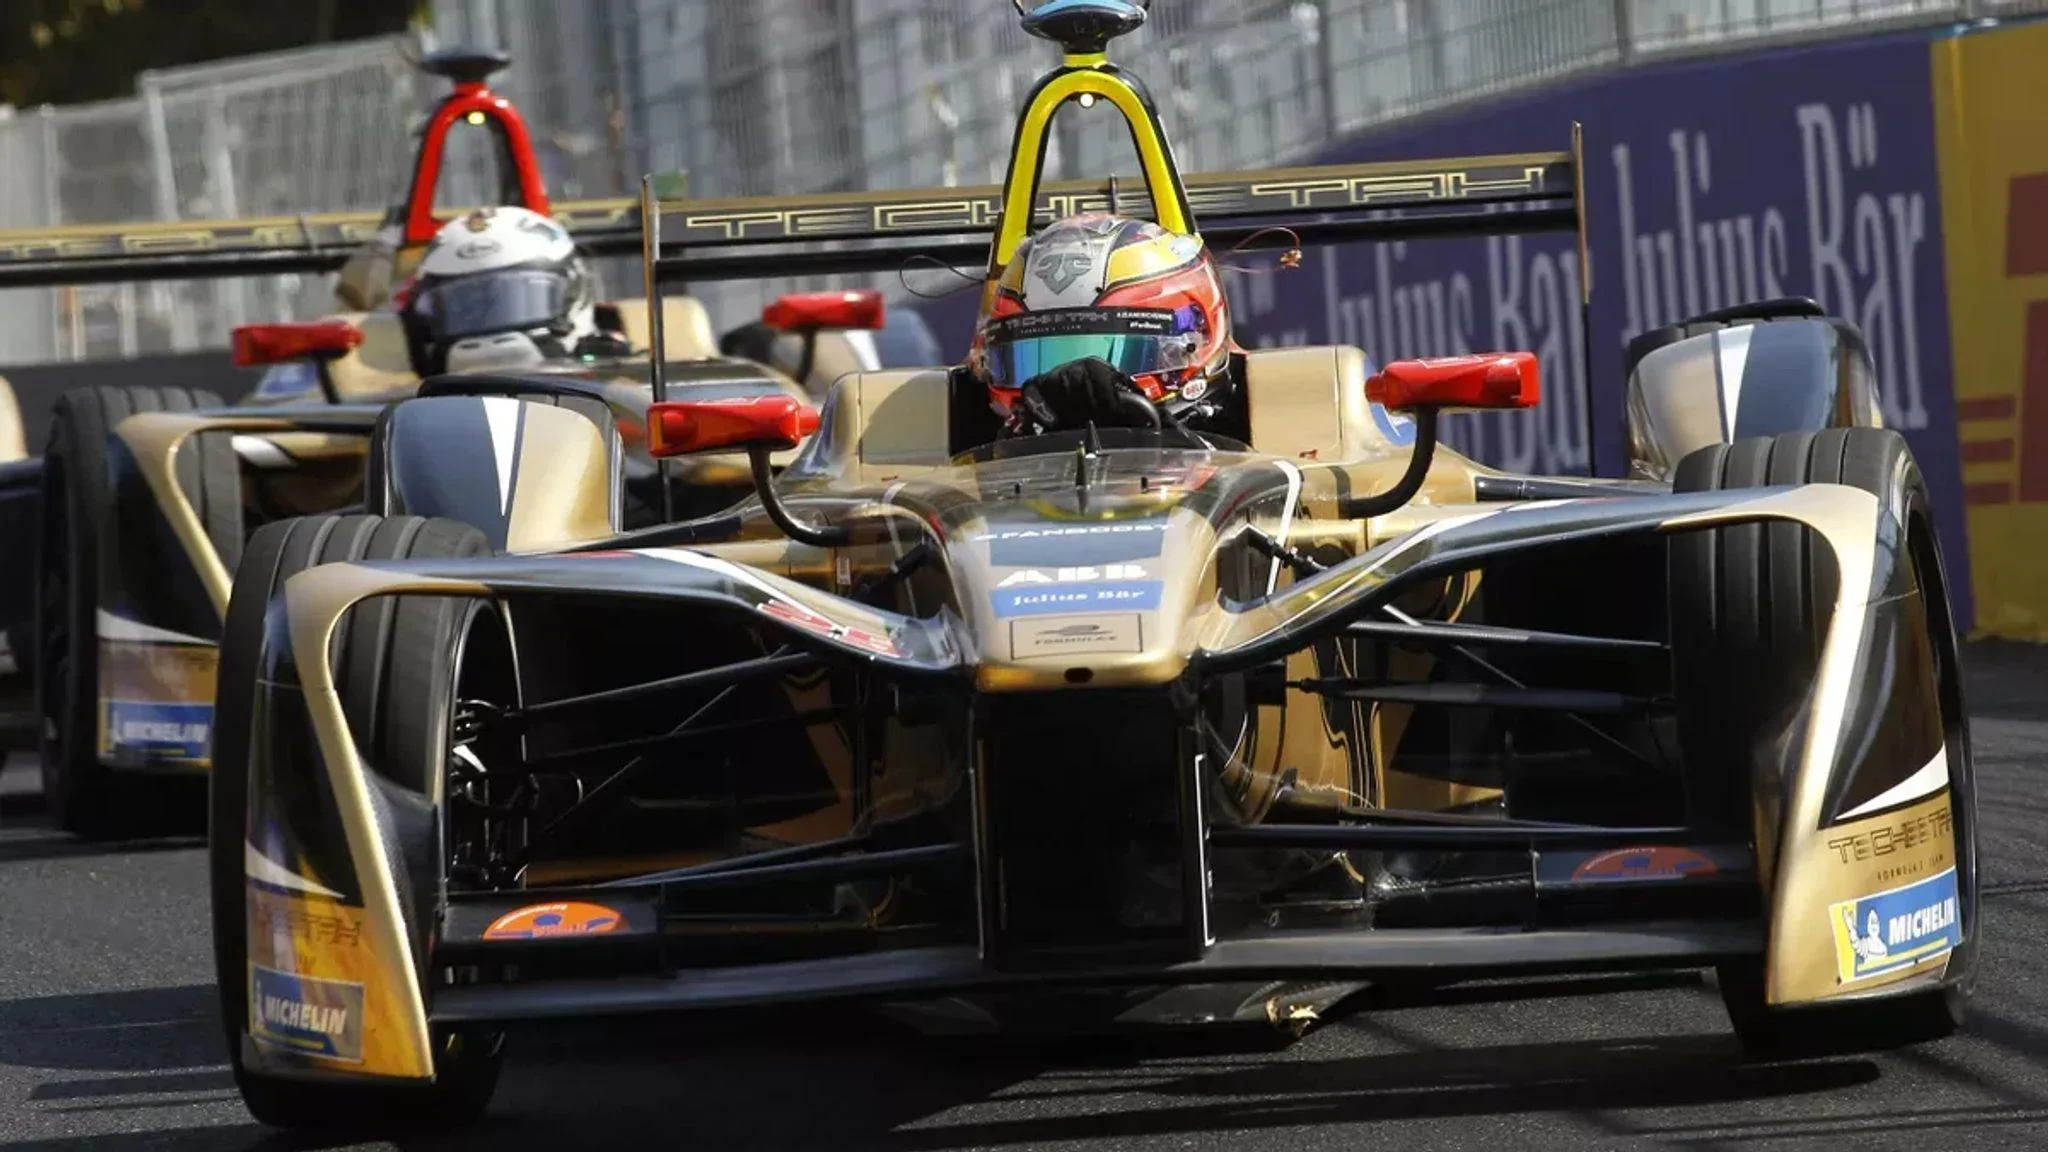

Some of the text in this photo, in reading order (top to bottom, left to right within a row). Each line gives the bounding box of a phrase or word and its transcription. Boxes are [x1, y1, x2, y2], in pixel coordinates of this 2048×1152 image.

[1797, 101, 1928, 428] Bär
[997, 564, 1147, 587] ABB
[1013, 592, 1088, 607] Julius
[1828, 806, 1953, 864] TECHEETA
[1888, 896, 1955, 946] MICHELIN
[264, 995, 348, 1036] MICHELIN
